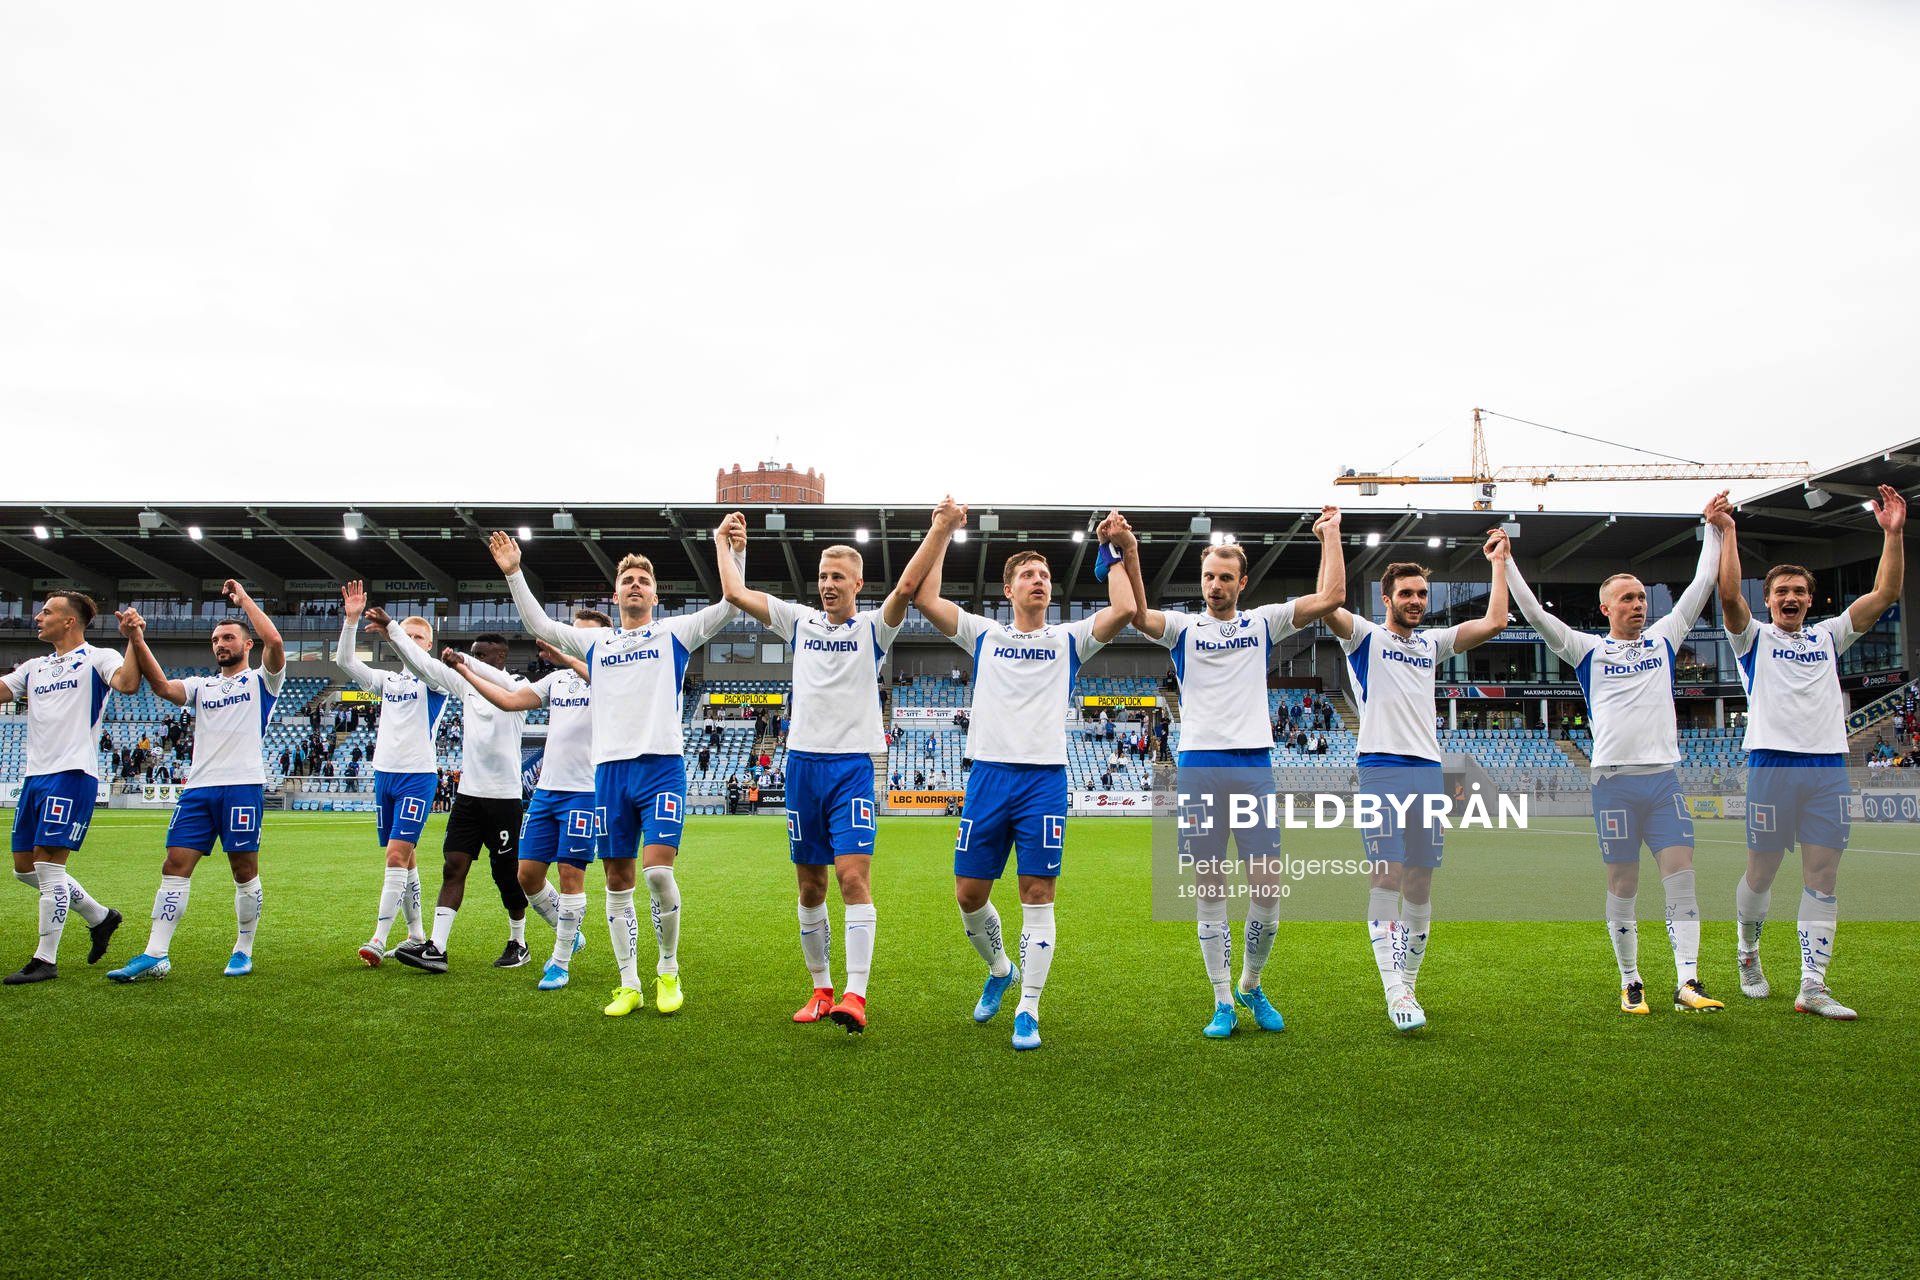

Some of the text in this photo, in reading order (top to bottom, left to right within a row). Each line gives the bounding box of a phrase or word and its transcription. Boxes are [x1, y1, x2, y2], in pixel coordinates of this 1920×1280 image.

[804, 640, 858, 652] HOLMEN
[1196, 636, 1259, 650] HOLMEN
[601, 649, 659, 667] HOLMEN
[994, 647, 1056, 660] HOLMEN
[1772, 648, 1829, 663] HOLMEN
[1604, 657, 1663, 675] HOLMEN
[1870, 675, 1887, 686] pepsi
[202, 692, 251, 710] HOLMEN
[724, 694, 768, 704] PACKOPLOCK
[1098, 697, 1142, 706] PACKOPLOCK
[893, 796, 964, 804] LBC NORRKP
[500, 830, 510, 846] 9
[1750, 832, 1758, 844] 3
[1183, 839, 1191, 853] 4
[1366, 840, 1379, 855] 14
[1602, 841, 1610, 855] 8
[52, 895, 68, 923] suez
